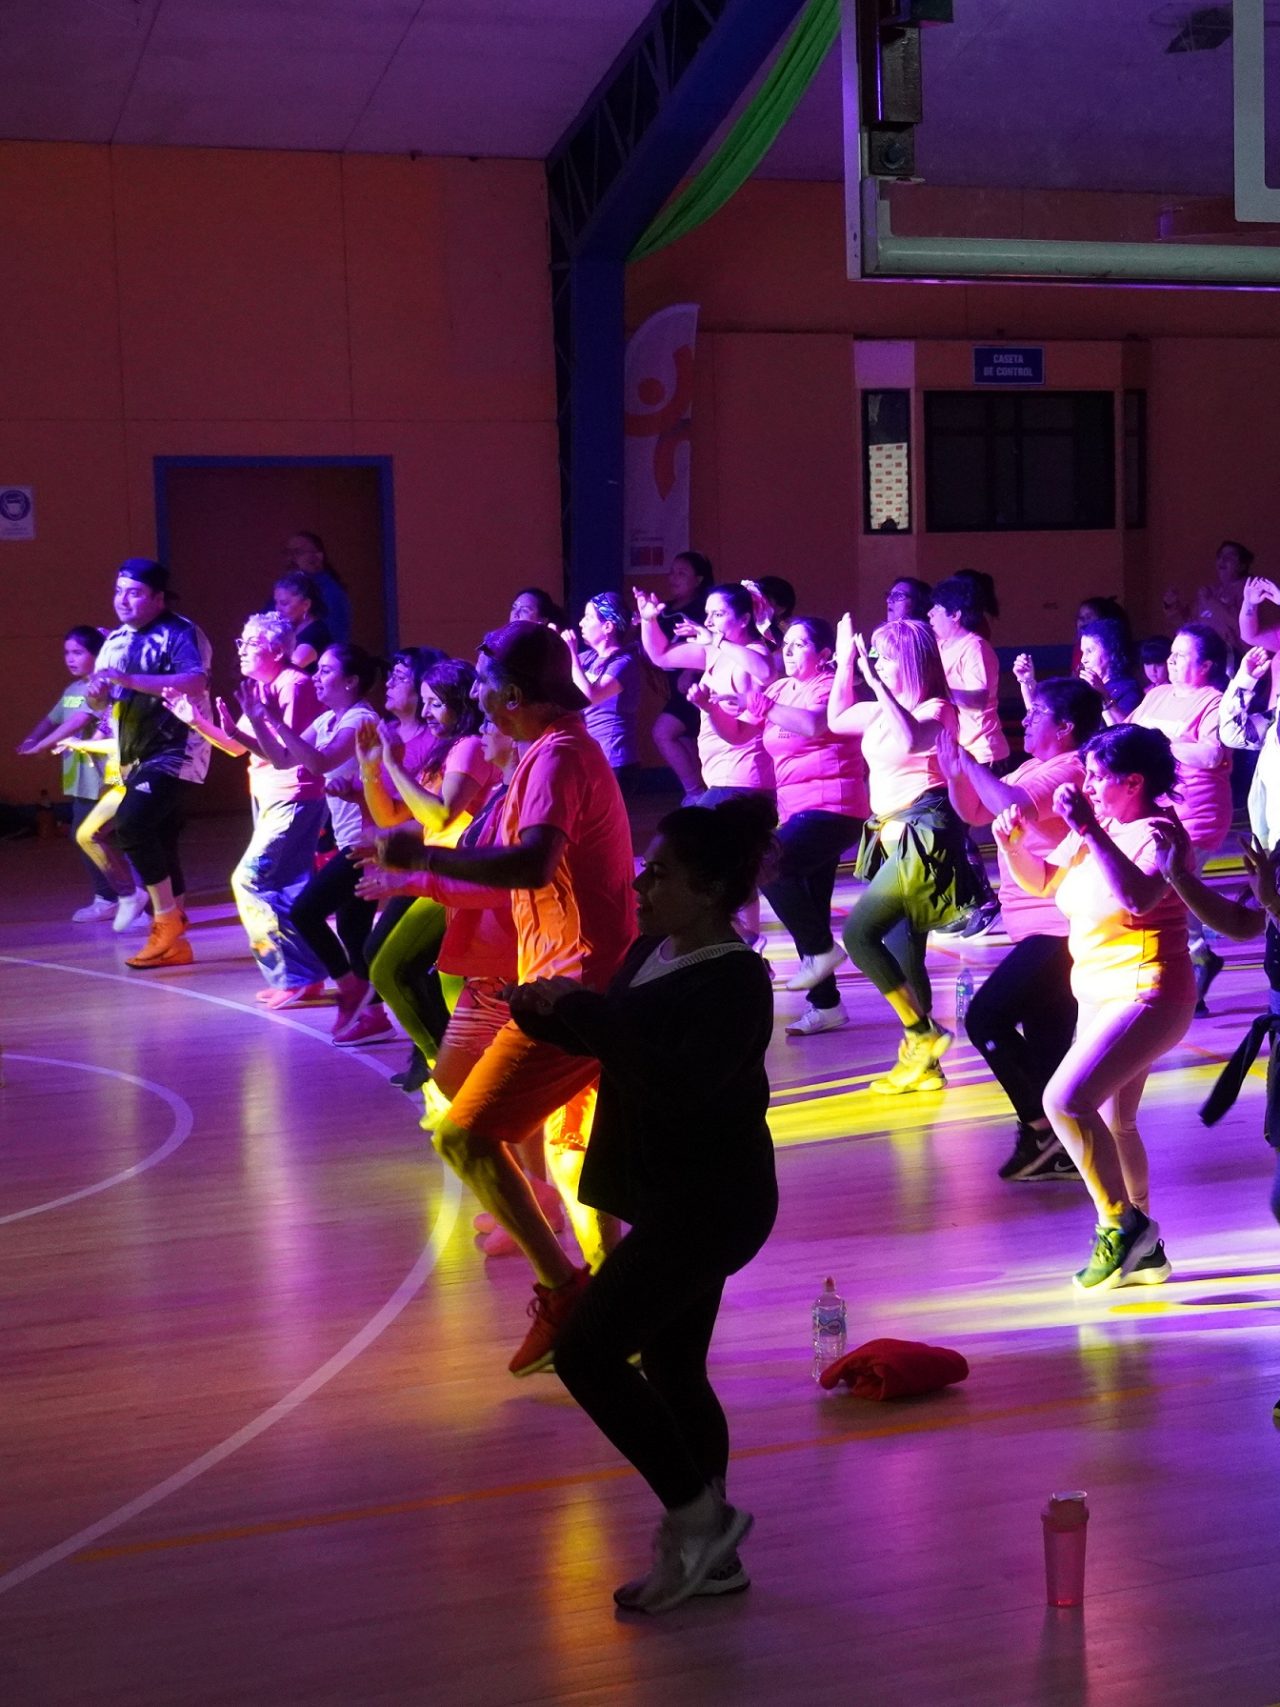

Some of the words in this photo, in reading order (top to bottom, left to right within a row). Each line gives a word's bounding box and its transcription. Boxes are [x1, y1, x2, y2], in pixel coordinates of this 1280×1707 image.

[993, 353, 1024, 363] CASETA
[983, 366, 994, 376] DE
[996, 366, 1033, 376] CONTROL
